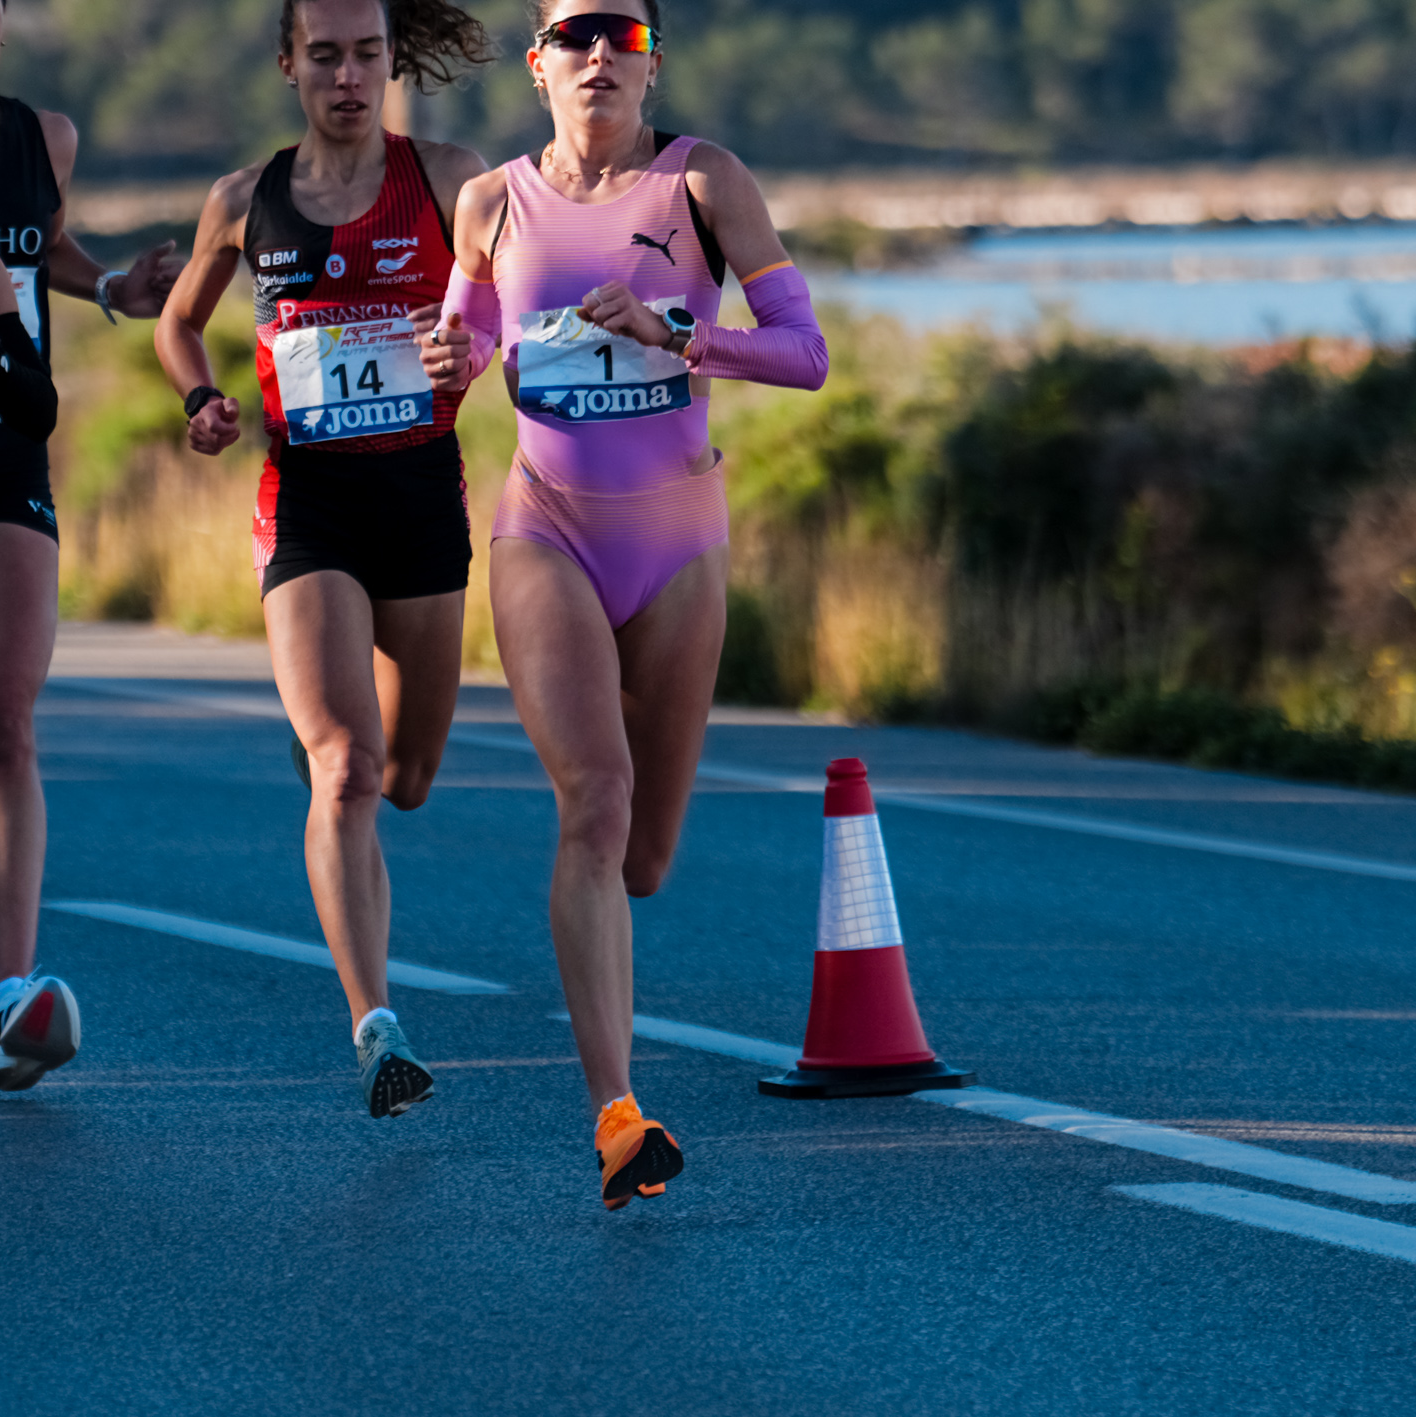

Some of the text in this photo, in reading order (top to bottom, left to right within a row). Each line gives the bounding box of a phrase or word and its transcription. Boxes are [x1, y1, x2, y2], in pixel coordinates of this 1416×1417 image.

[272, 250, 298, 266] BM
[330, 261, 341, 273] B
[367, 273, 424, 285] emteSPORT
[344, 322, 393, 338] RFEA
[340, 332, 415, 347] ATLETISMO
[594, 344, 613, 382] 1
[329, 360, 384, 399] 14
